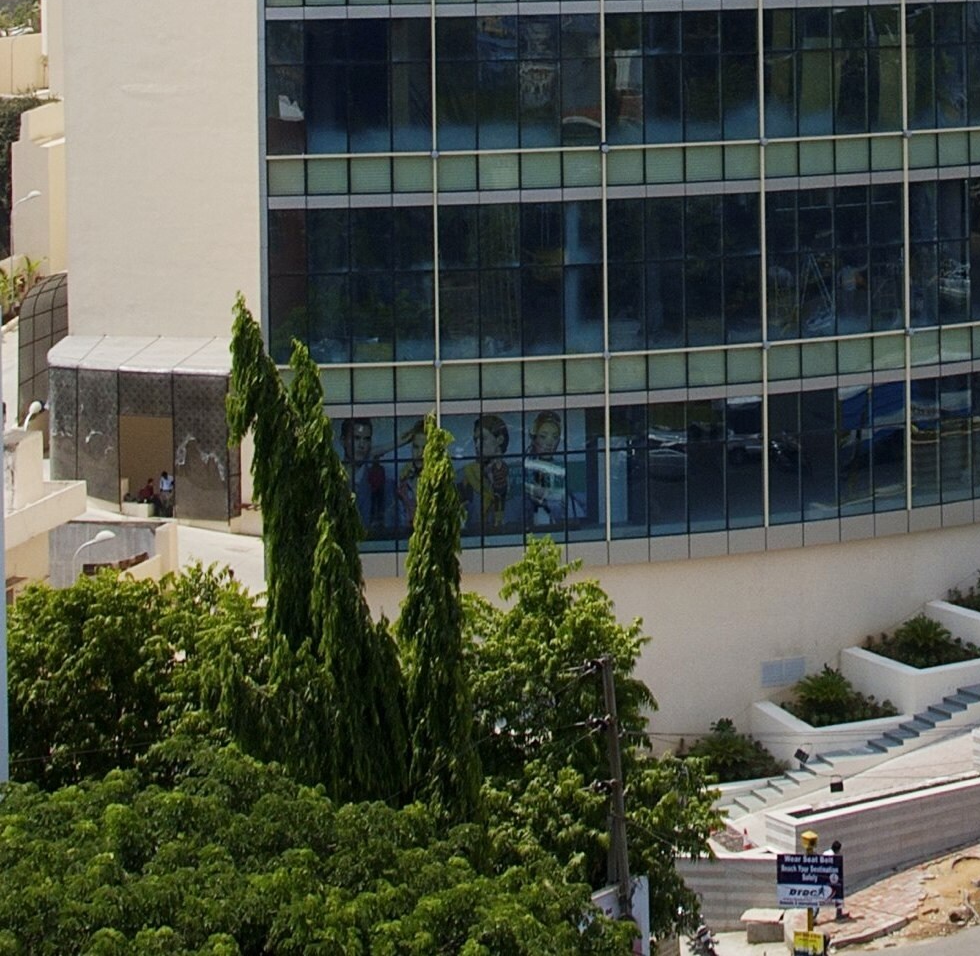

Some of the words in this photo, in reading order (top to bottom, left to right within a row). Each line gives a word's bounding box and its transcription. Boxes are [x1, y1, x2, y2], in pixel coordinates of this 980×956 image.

[784, 855, 801, 863] Wear
[803, 855, 818, 863] Seat
[820, 856, 834, 864] Belt
